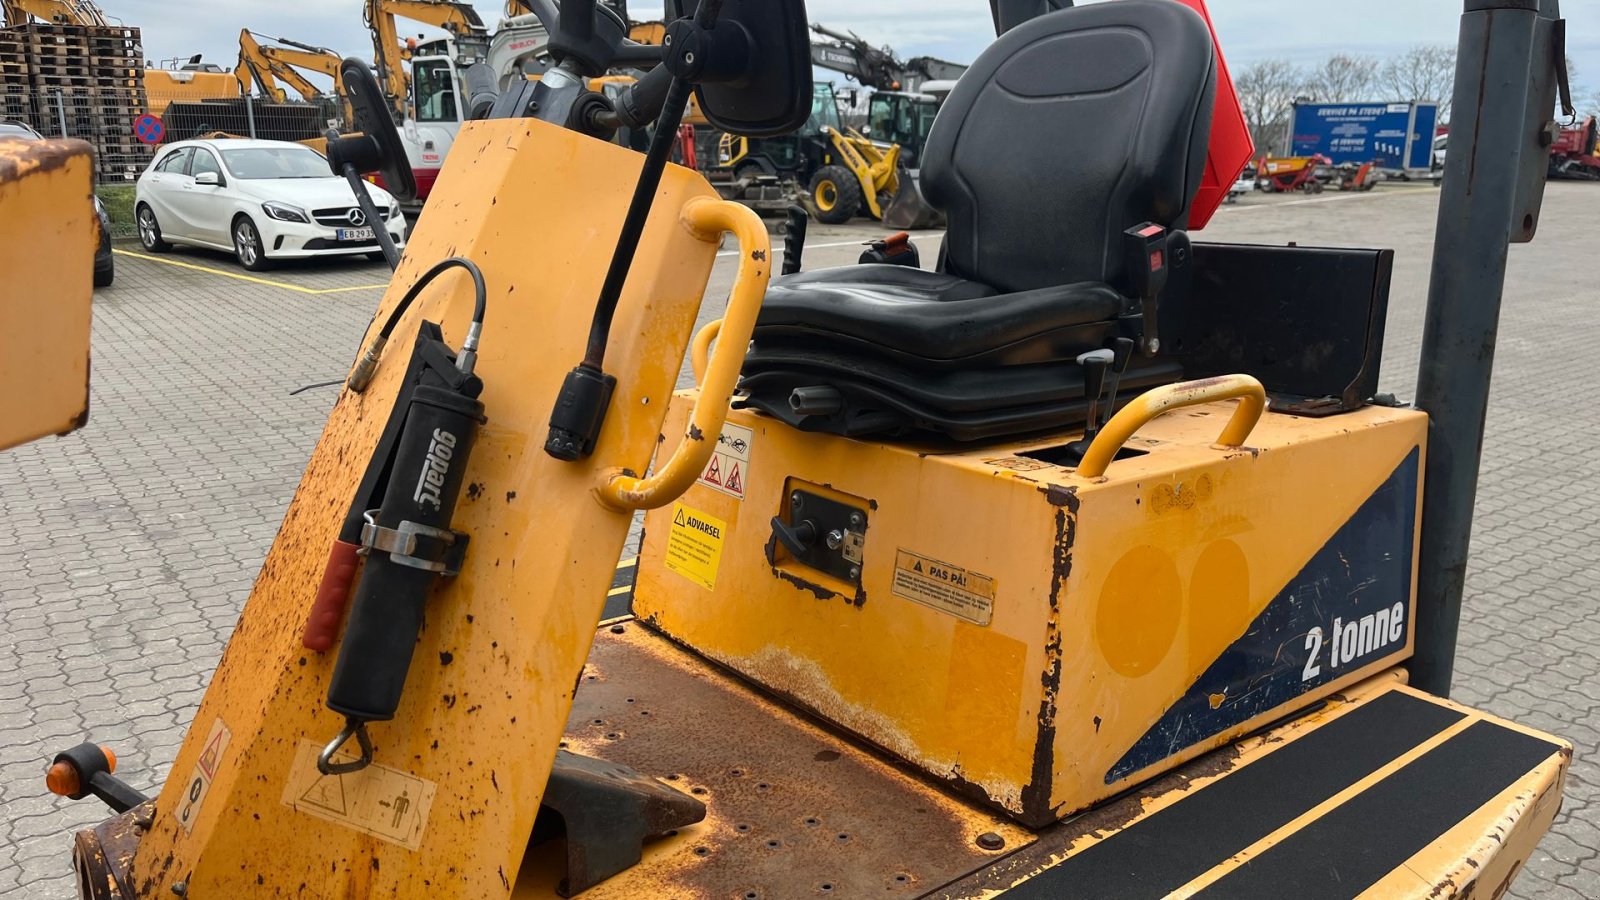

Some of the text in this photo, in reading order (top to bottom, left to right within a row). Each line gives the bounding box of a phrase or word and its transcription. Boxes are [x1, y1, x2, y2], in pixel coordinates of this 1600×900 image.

[344, 230, 355, 239] EB
[355, 230, 365, 238] 29
[413, 427, 457, 505] gopart
[686, 515, 720, 539] ADVARSEL
[929, 566, 967, 587] PAS PÅ!
[1302, 601, 1404, 682] 2 tonne
